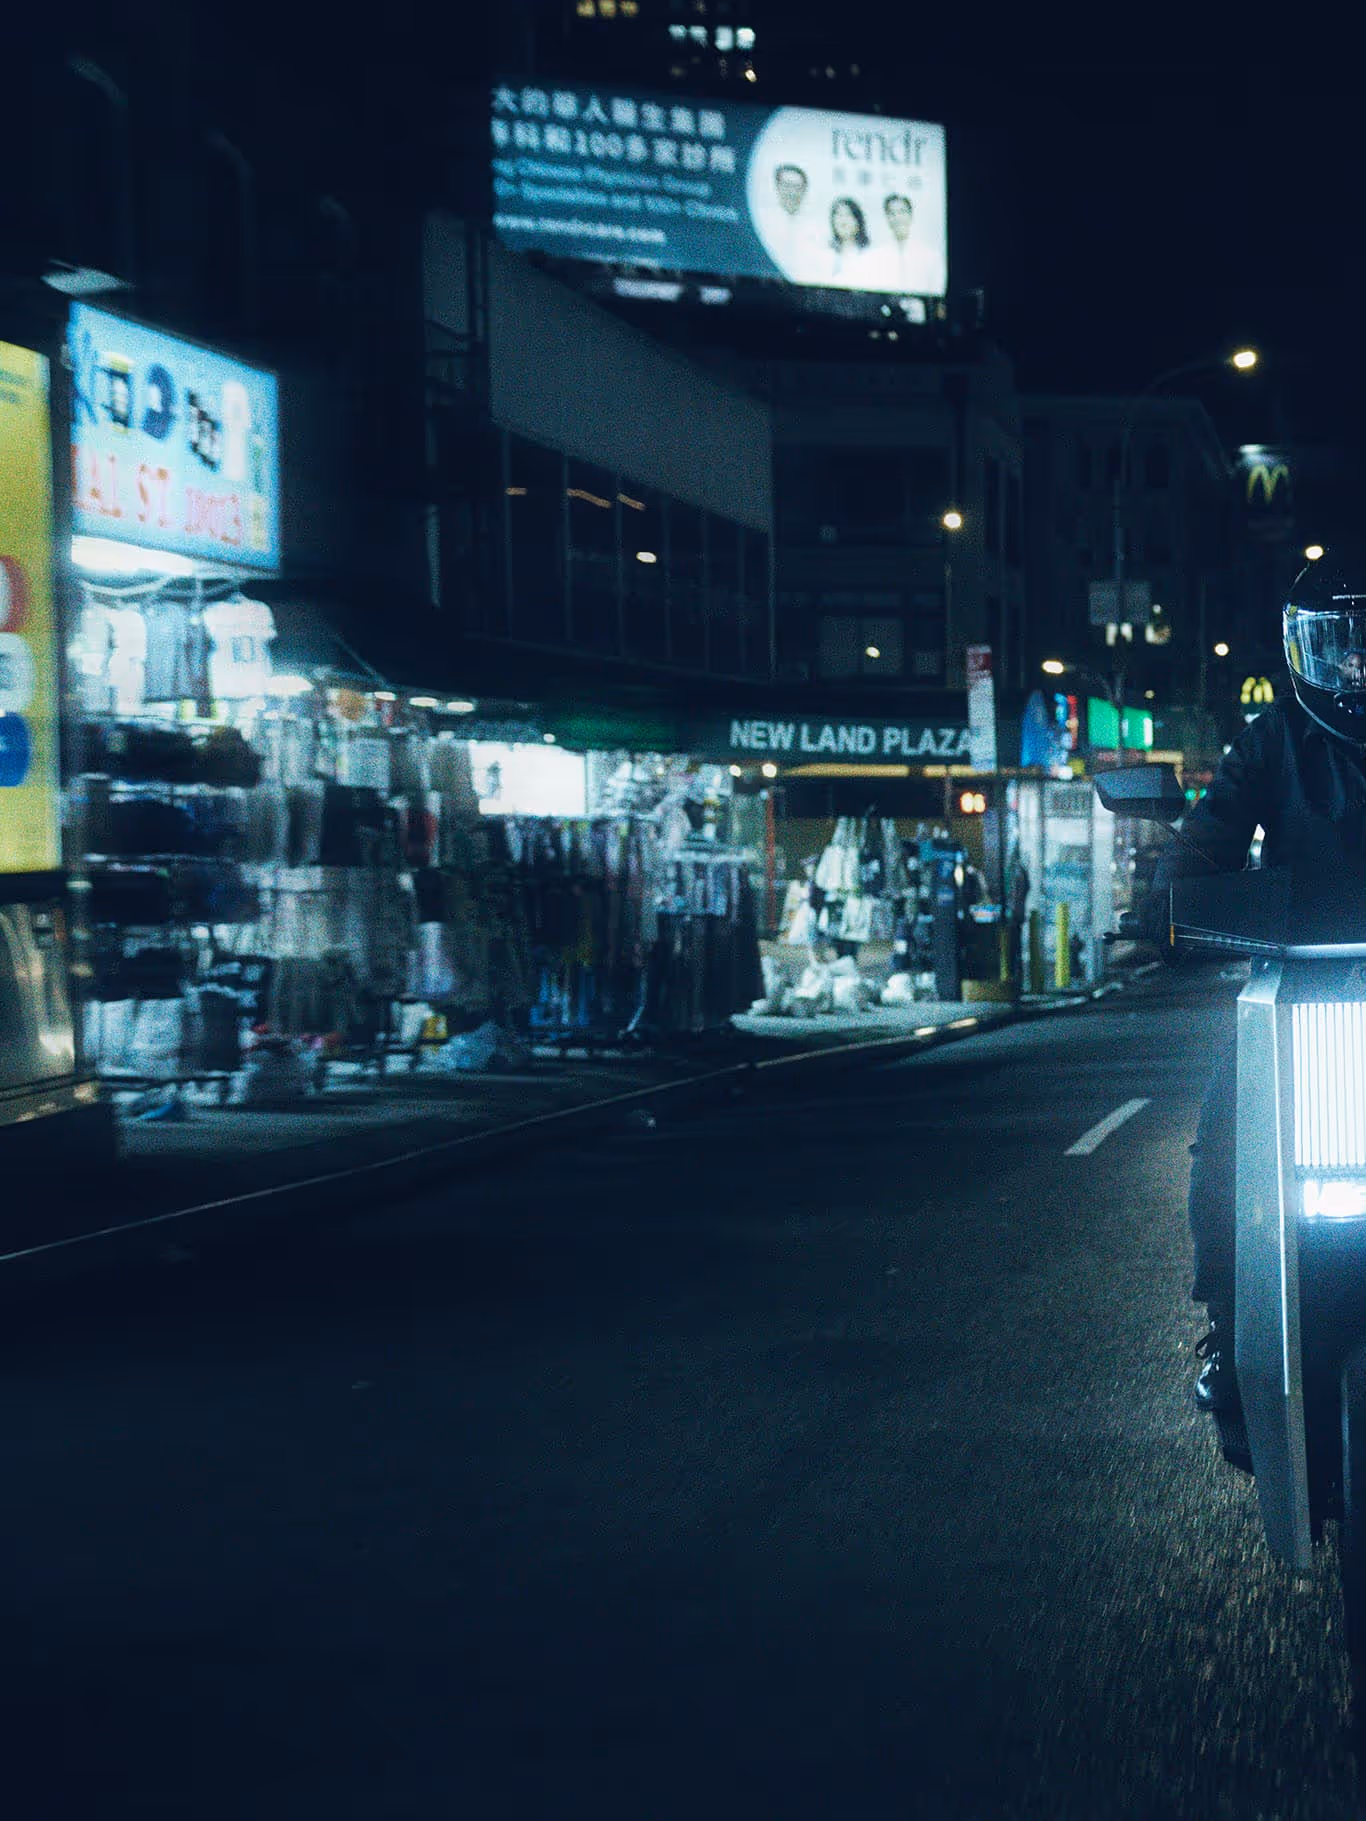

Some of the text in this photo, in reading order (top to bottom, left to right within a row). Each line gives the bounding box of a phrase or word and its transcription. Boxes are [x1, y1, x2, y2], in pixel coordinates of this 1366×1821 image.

[832, 128, 928, 166] rendr
[729, 720, 973, 757] NEW LAND PLAZA
